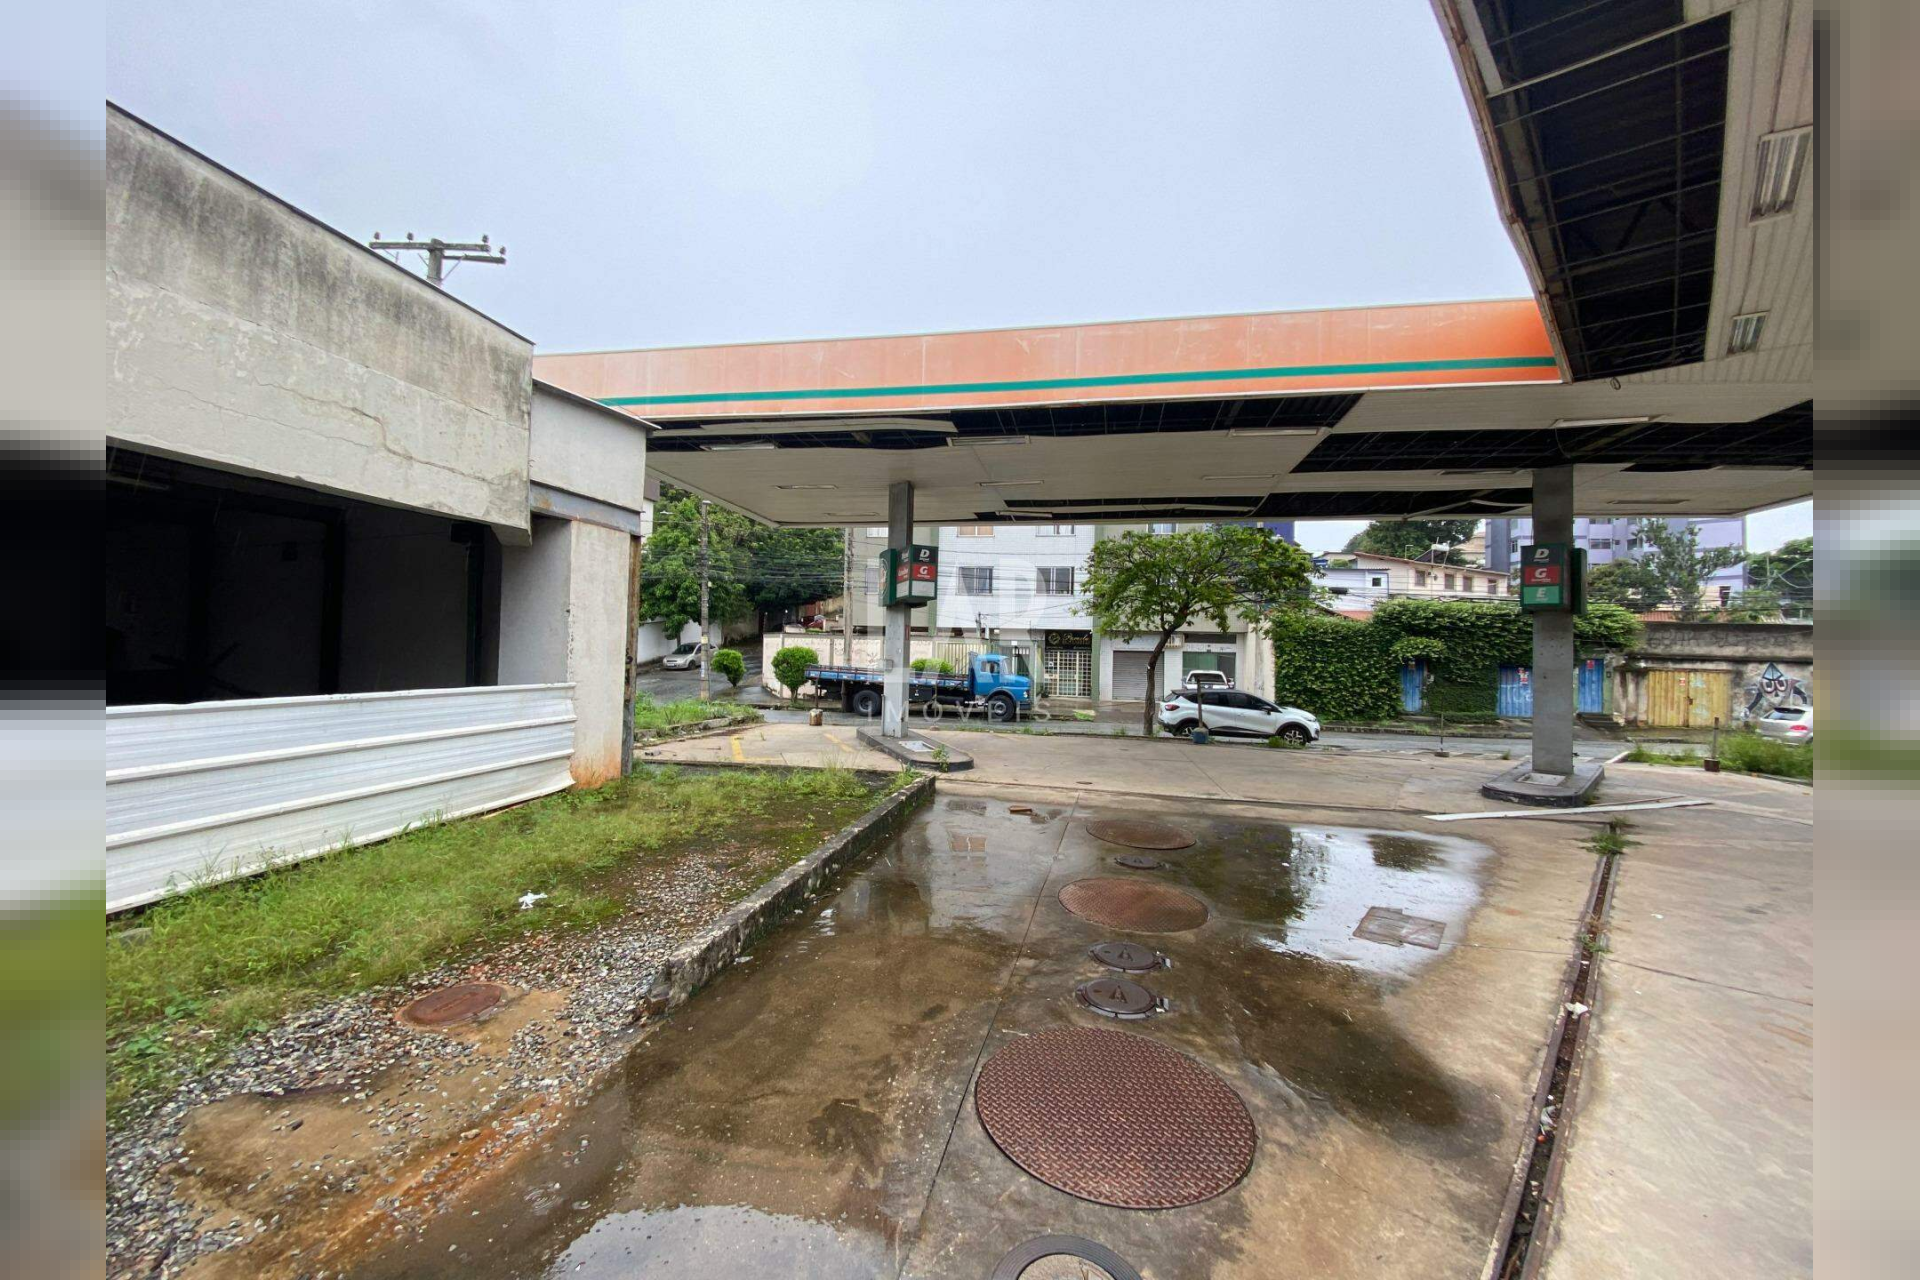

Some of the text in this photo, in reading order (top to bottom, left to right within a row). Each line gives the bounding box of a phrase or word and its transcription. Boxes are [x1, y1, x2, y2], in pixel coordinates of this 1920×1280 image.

[920, 549, 930, 558] D
[1534, 548, 1550, 559] D
[920, 566, 929, 575] G
[1534, 568, 1548, 578] G
[1536, 587, 1547, 598] E
